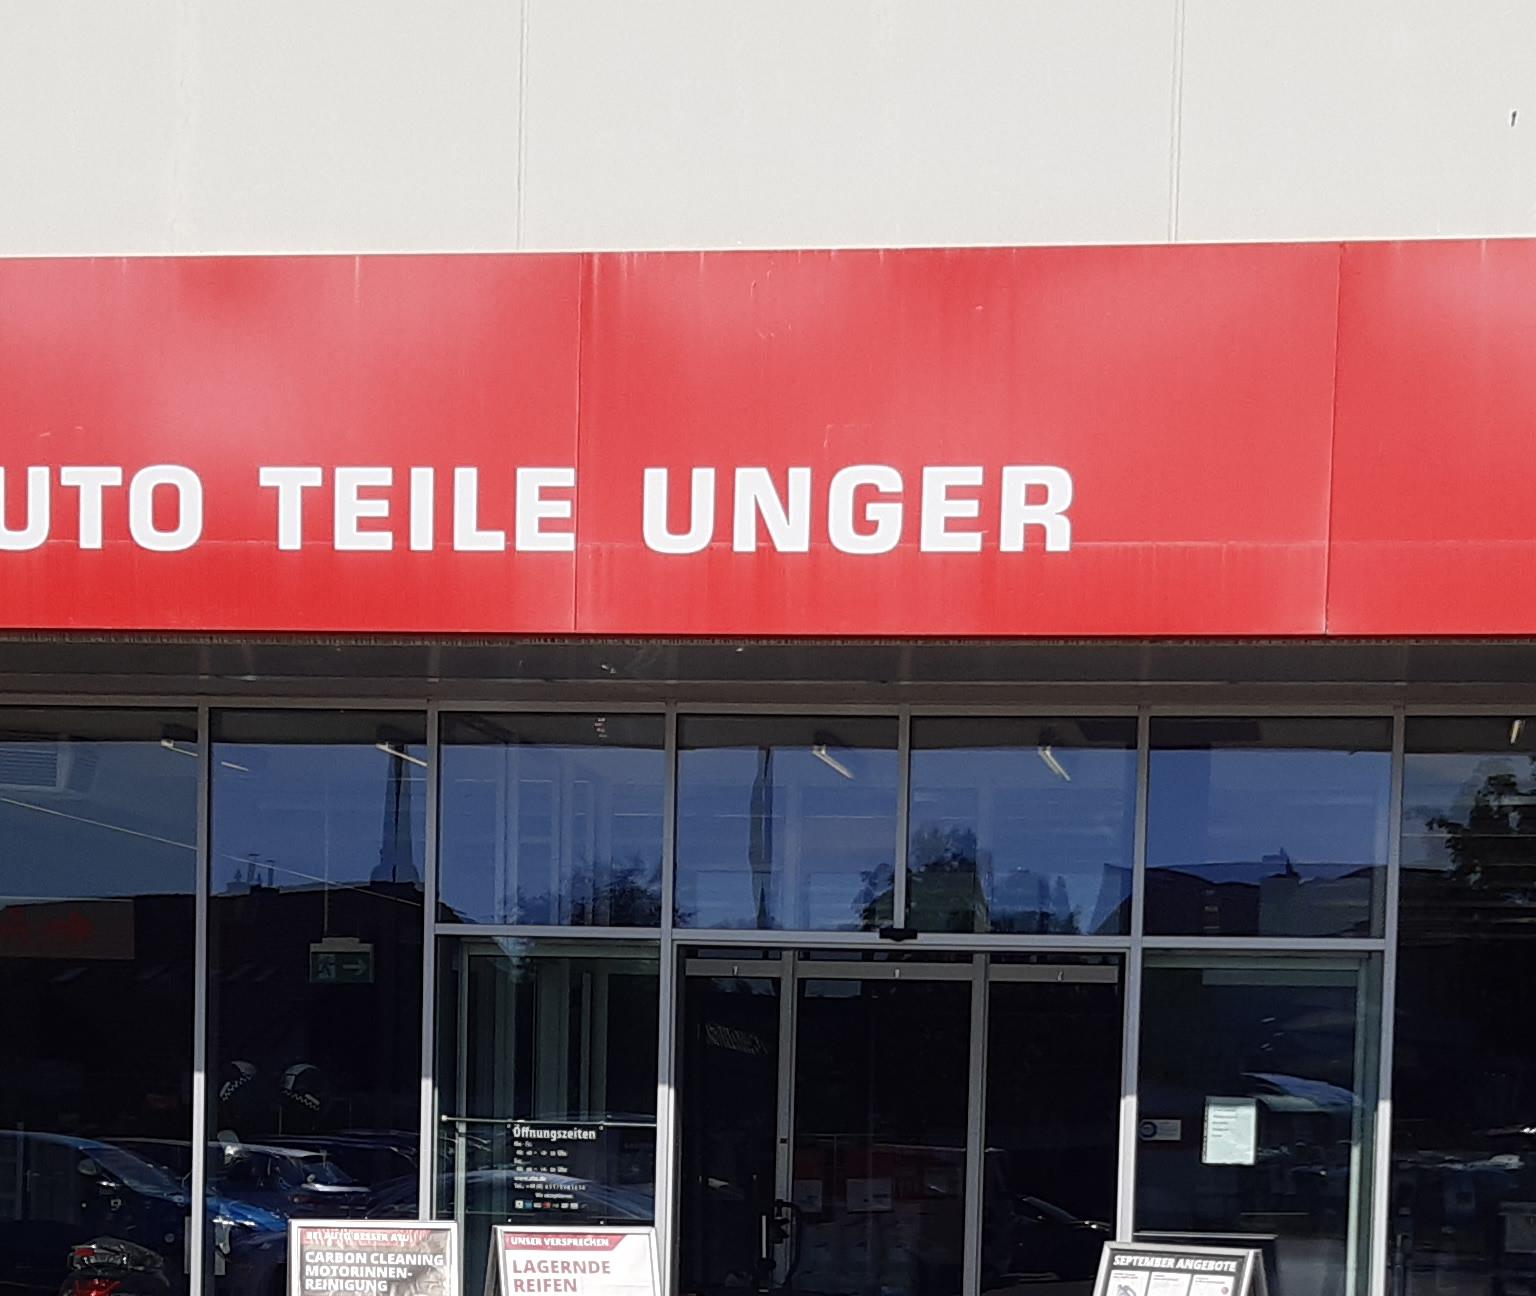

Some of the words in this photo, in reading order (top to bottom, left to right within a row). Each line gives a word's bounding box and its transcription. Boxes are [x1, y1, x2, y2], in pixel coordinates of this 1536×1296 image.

[259, 465, 577, 553] TEILE
[642, 463, 1075, 555] UNGER
[513, 1124, 596, 1141] Öffnungszeiten
[510, 1236, 543, 1246] UNSER
[544, 1237, 609, 1247] VERSPRECHEN
[305, 1251, 367, 1265] CARBON
[370, 1252, 444, 1266] CLEANING
[1113, 1255, 1175, 1268] SEPTEMBER
[1176, 1259, 1238, 1273] ANGEBOTE
[305, 1265, 413, 1278] MOTORINNEN-
[513, 1260, 611, 1274] LAGERNDE
[305, 1278, 388, 1292] REINIGUNG
[514, 1278, 577, 1292] REIFEN
